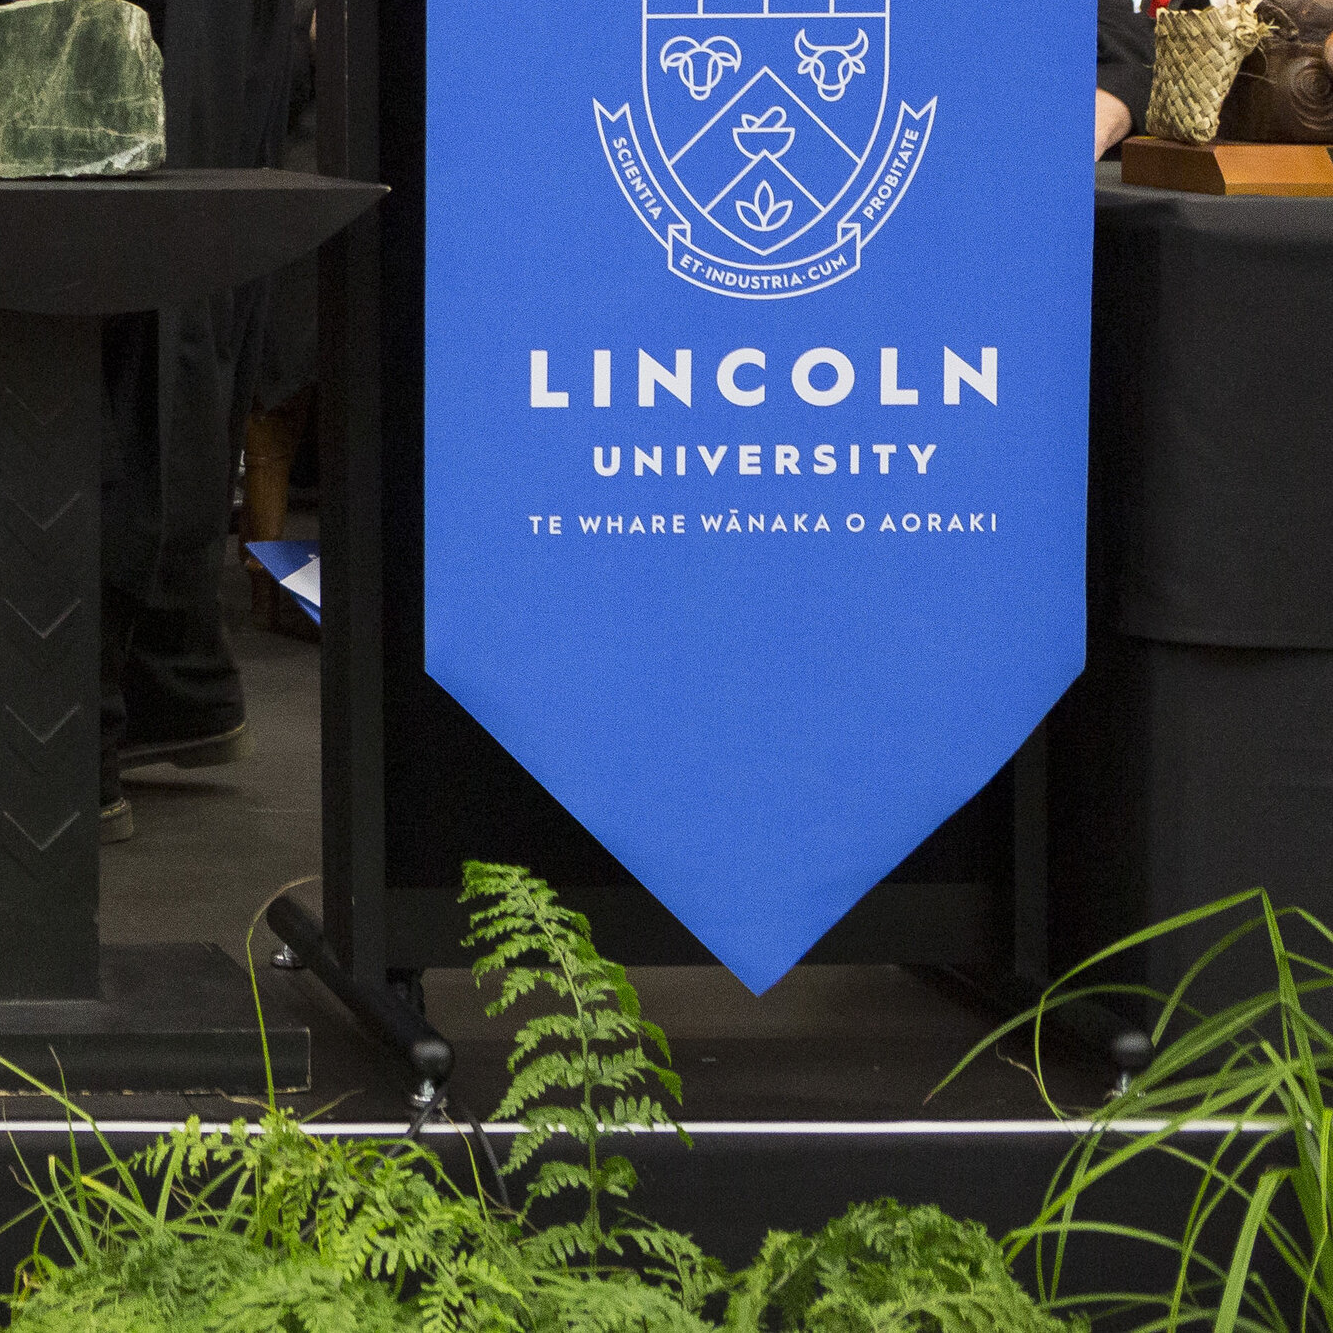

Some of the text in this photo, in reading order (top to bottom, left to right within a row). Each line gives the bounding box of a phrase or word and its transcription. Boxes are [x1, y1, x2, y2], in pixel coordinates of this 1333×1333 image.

[612, 136, 663, 221] SCIENTIA
[861, 127, 920, 221] PROBITATE
[530, 346, 998, 408] LINCOLN
[593, 444, 937, 477] UNIVERSITY
[529, 509, 997, 534] TE WHARE WĀNAKA O AORAKI
